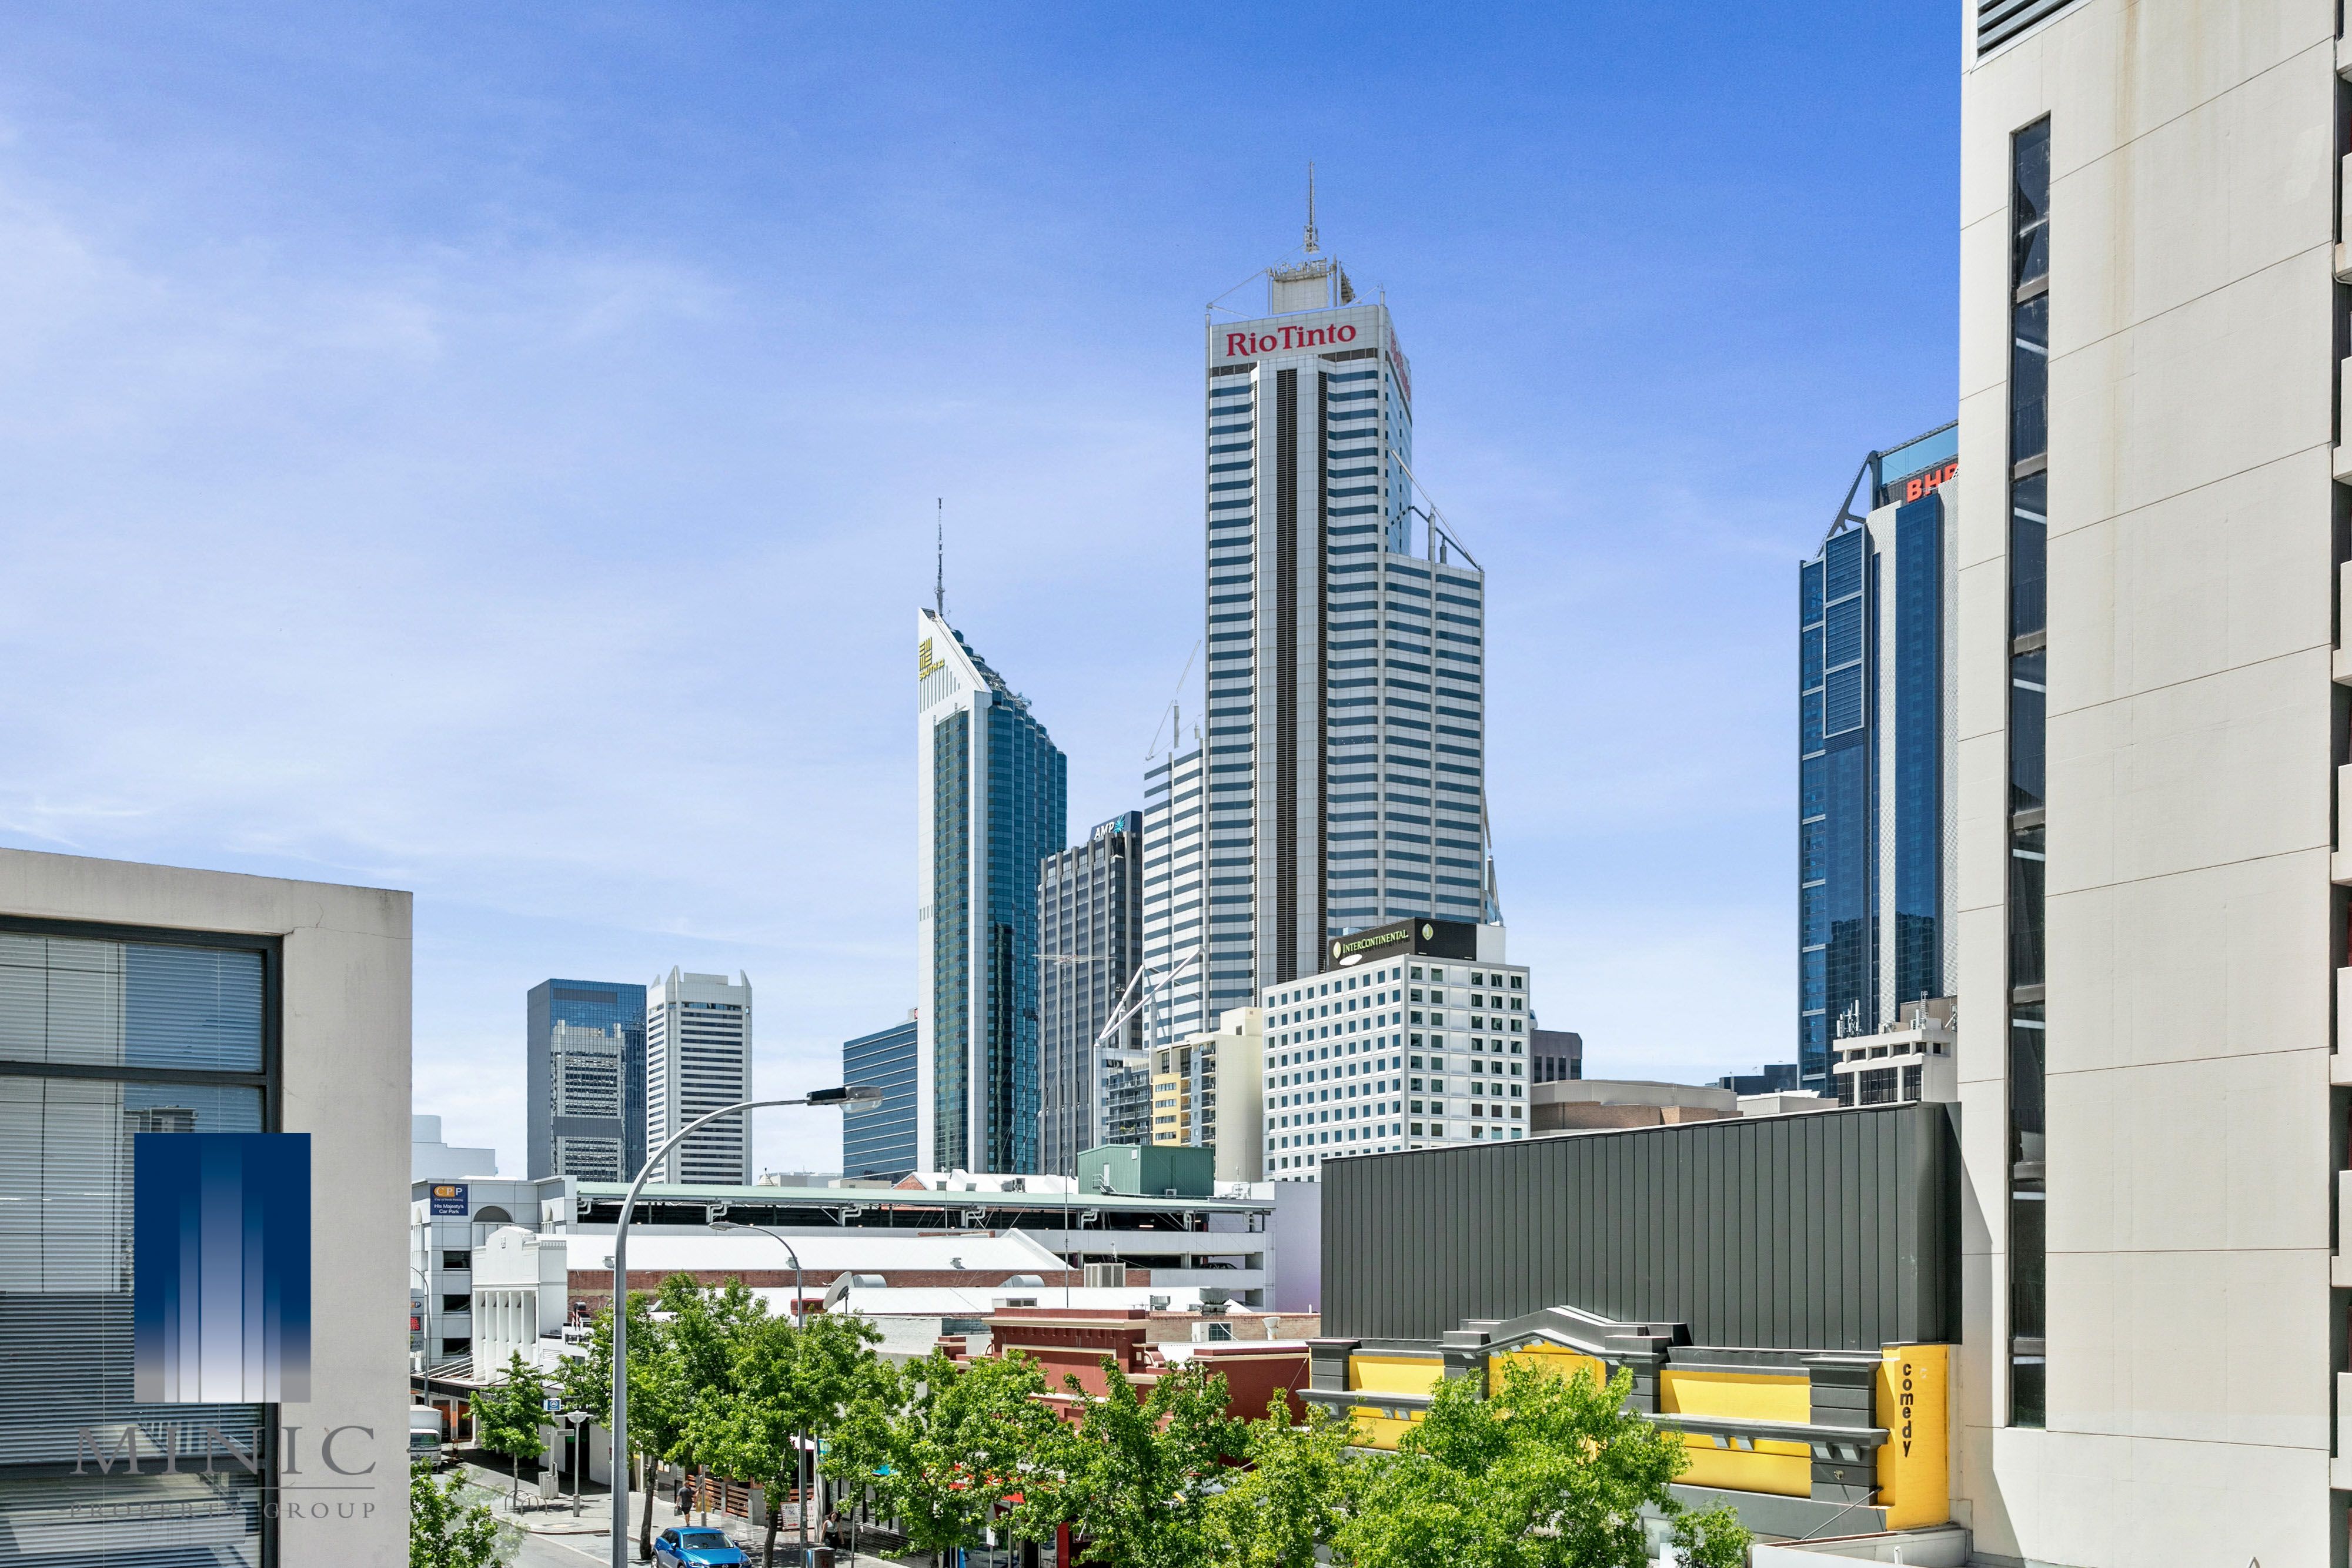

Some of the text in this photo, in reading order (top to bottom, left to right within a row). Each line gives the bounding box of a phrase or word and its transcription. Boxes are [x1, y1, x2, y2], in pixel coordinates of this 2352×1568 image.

[1907, 463, 1958, 504] BHP
[1094, 821, 1115, 840] AMP
[1900, 1363, 1913, 1458] comedy
